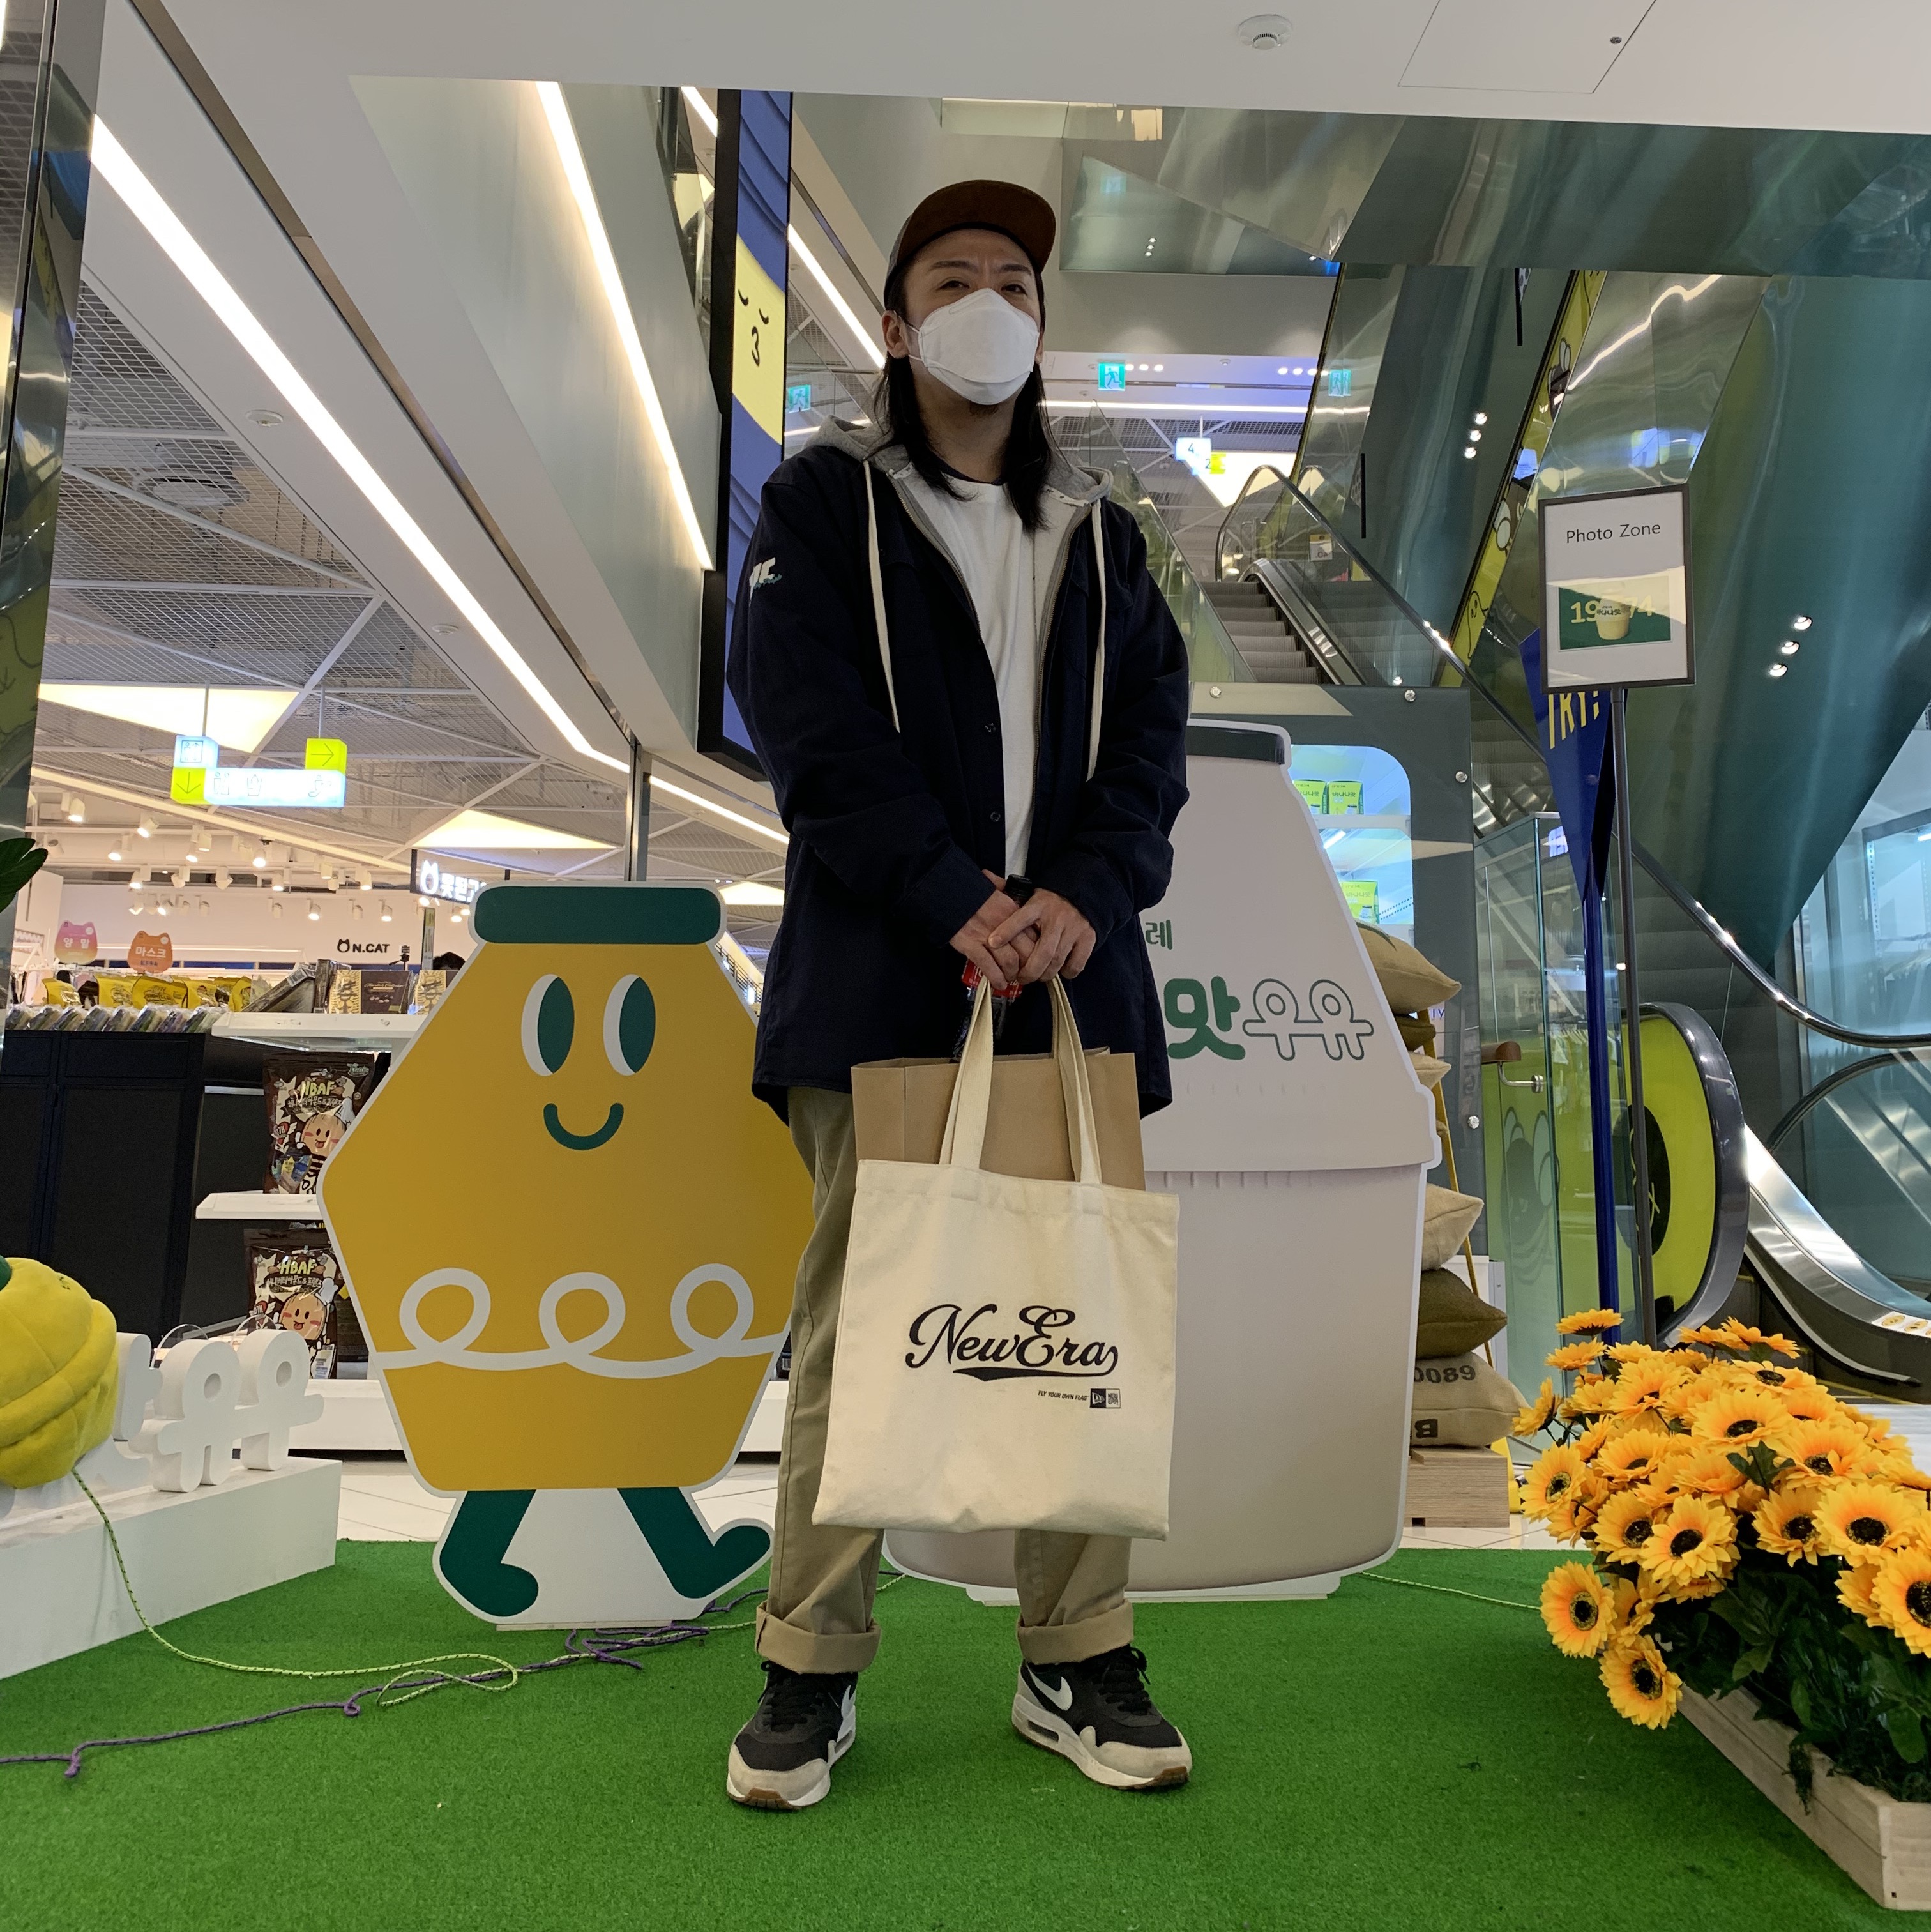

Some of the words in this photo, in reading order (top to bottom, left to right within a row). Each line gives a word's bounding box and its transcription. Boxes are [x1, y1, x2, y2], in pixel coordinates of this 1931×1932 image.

[1188, 443, 1194, 453] 4
[1566, 529, 1613, 543] Photo
[1619, 524, 1661, 538] Zone
[135, 947, 166, 958] 마스크
[300, 1080, 335, 1096] HBAF
[280, 1258, 316, 1275] HBAF
